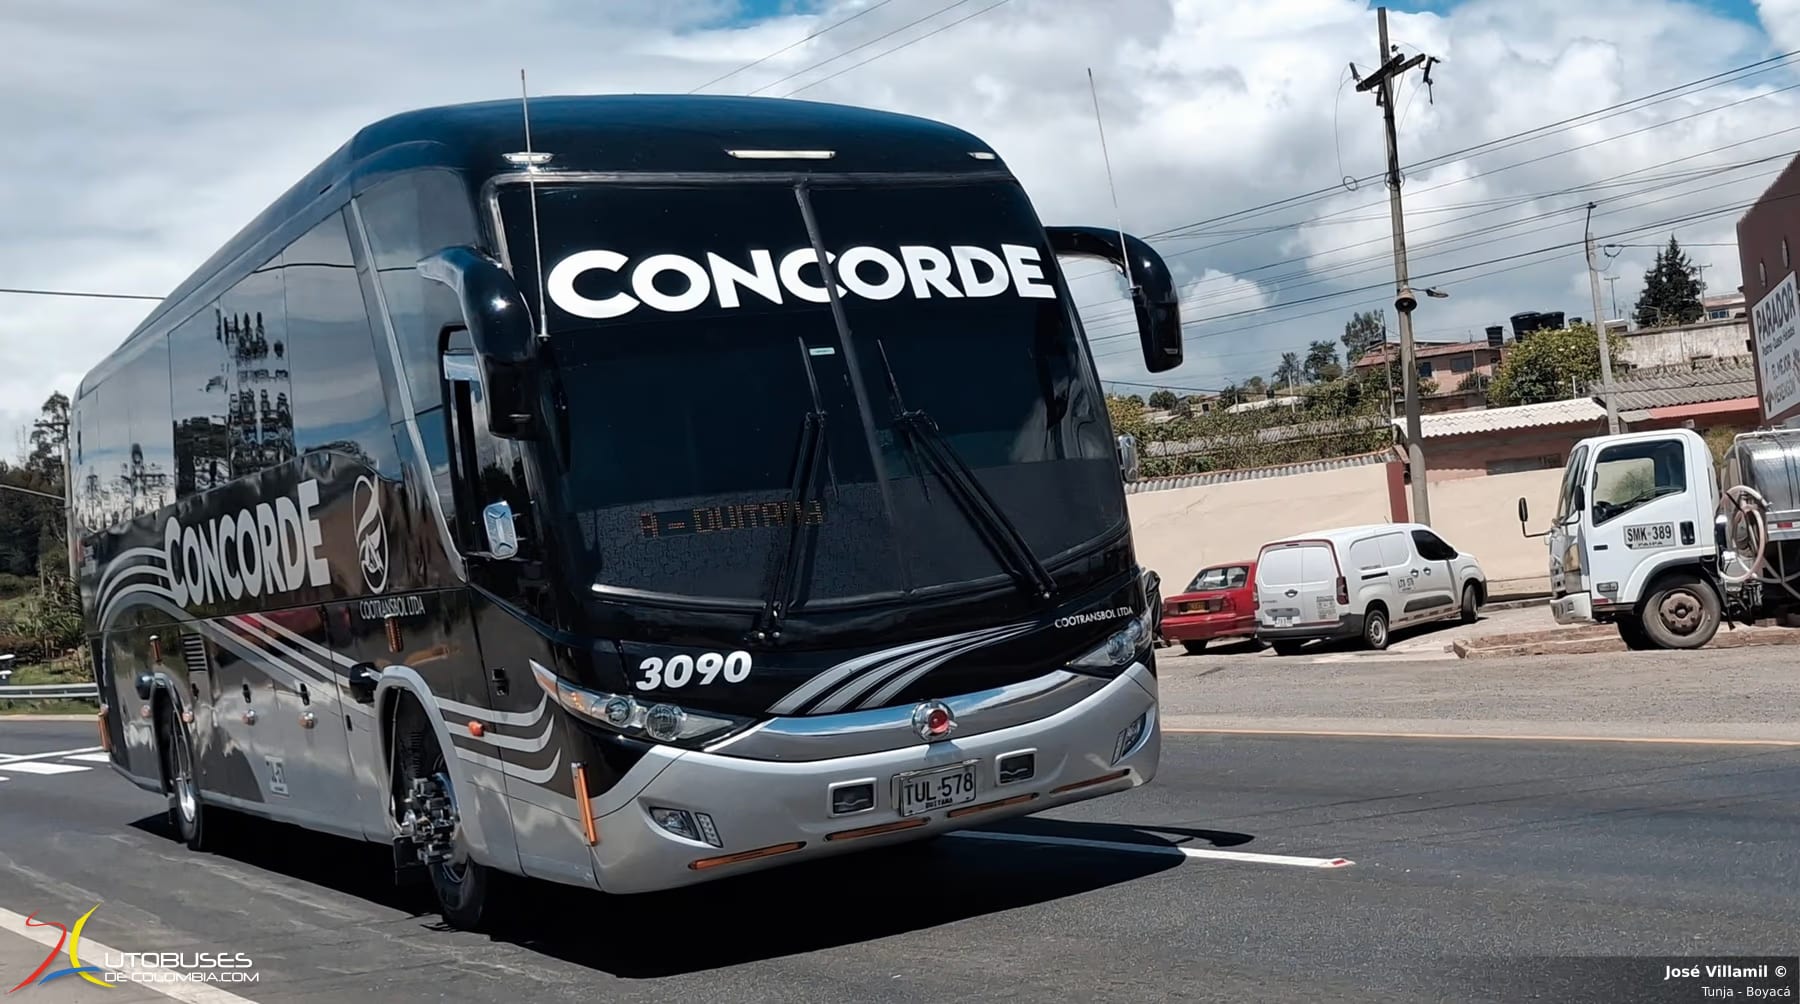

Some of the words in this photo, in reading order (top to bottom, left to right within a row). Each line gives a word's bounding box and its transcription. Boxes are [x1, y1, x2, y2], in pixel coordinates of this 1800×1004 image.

[547, 243, 1057, 319] CONCORDE
[1756, 281, 1796, 342] PARADOR
[164, 479, 332, 608] CONCORDE
[360, 596, 408, 619] COOTRANSBOL
[407, 595, 426, 616] LTDA
[1054, 608, 1116, 629] COOTRANSBOL
[1117, 605, 1133, 617] LTDA
[635, 650, 753, 691] 3090
